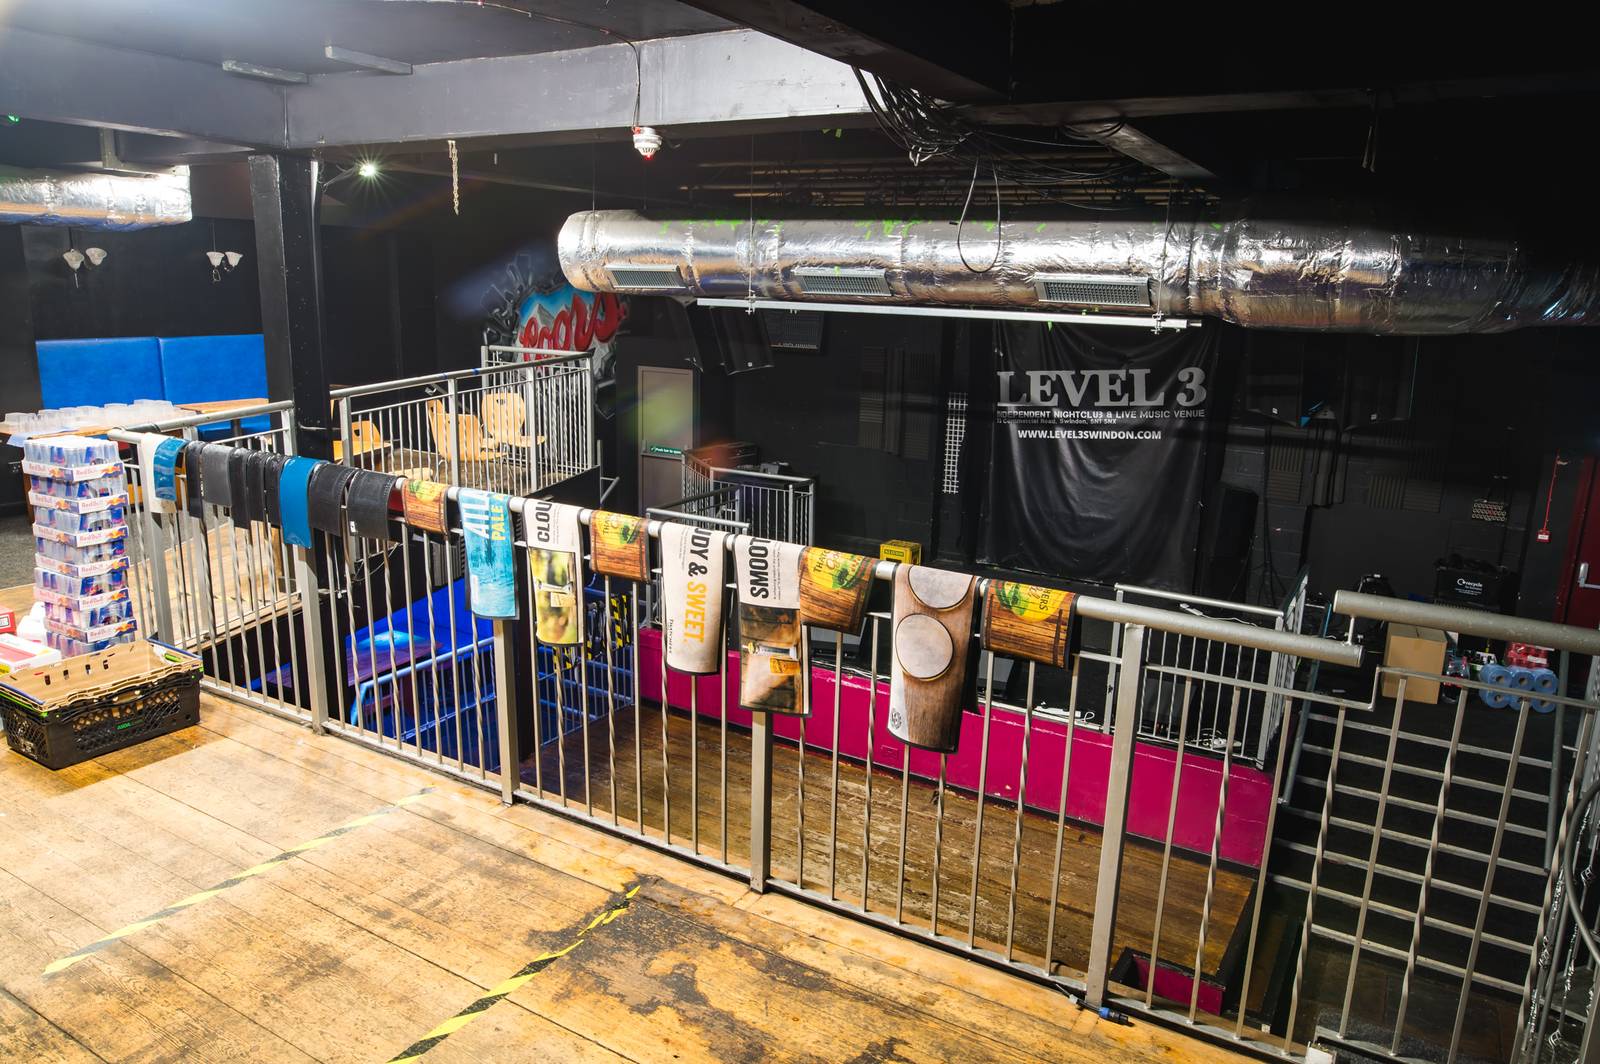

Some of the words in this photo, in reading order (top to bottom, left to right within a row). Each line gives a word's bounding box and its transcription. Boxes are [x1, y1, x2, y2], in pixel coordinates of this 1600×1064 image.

[996, 369, 1164, 407] LEVEL
[1176, 367, 1207, 407] 3
[1053, 410, 1104, 419] NIGHTCLUB
[1106, 411, 1113, 419] &
[1115, 410, 1137, 419] LIVE
[1139, 410, 1171, 419] MUSIC
[1173, 409, 1205, 418] VENUE
[1017, 430, 1162, 440] WWW.LEVEL3SWINDON.COM
[491, 504, 507, 541] PALE
[687, 561, 708, 578] &
